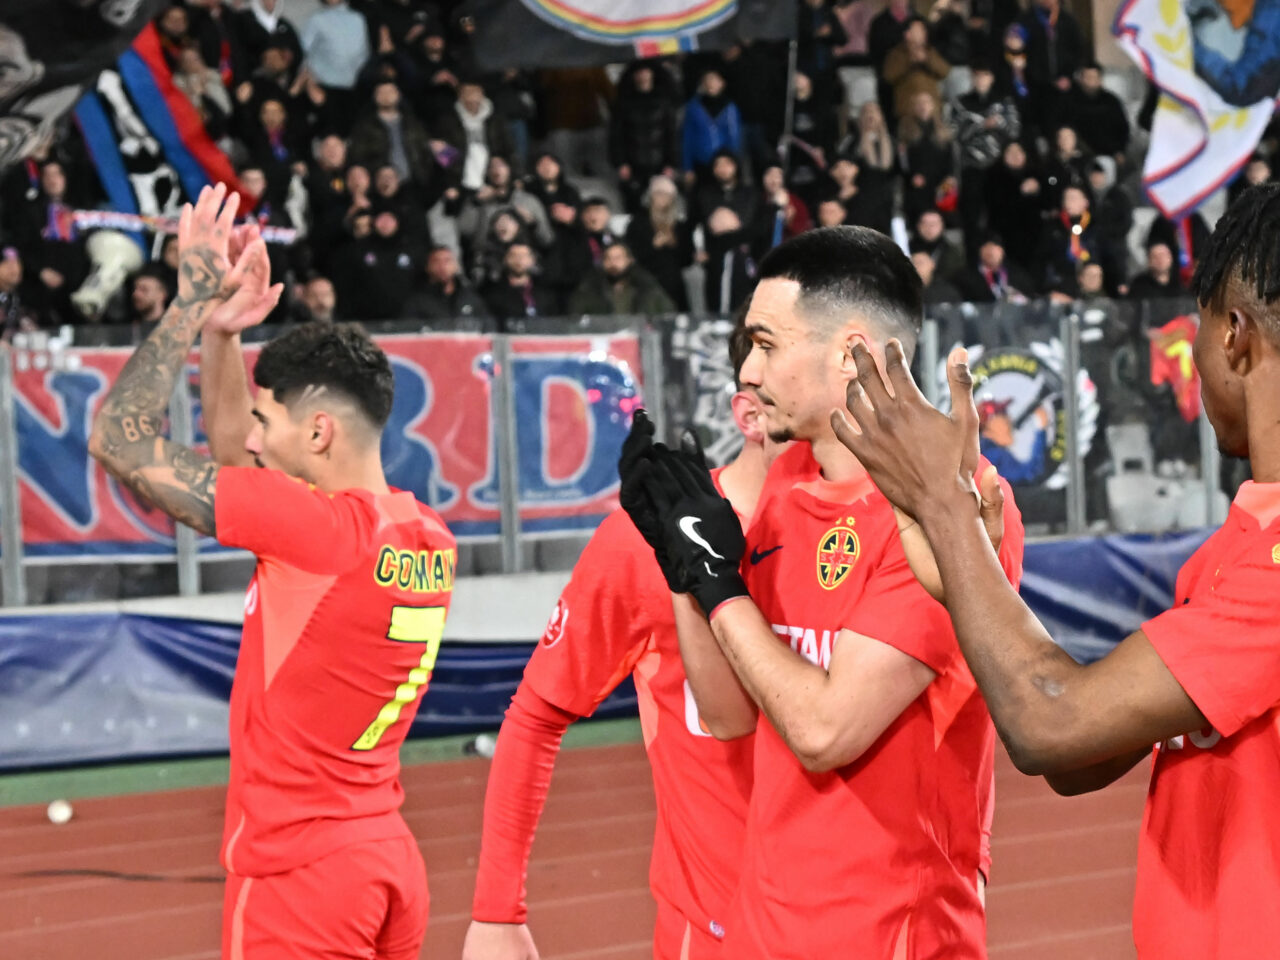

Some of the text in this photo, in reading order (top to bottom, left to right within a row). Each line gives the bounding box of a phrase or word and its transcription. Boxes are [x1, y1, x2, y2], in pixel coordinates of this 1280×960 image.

[12, 353, 642, 547] ND
[121, 415, 155, 443] 86
[350, 605, 447, 751] 7
